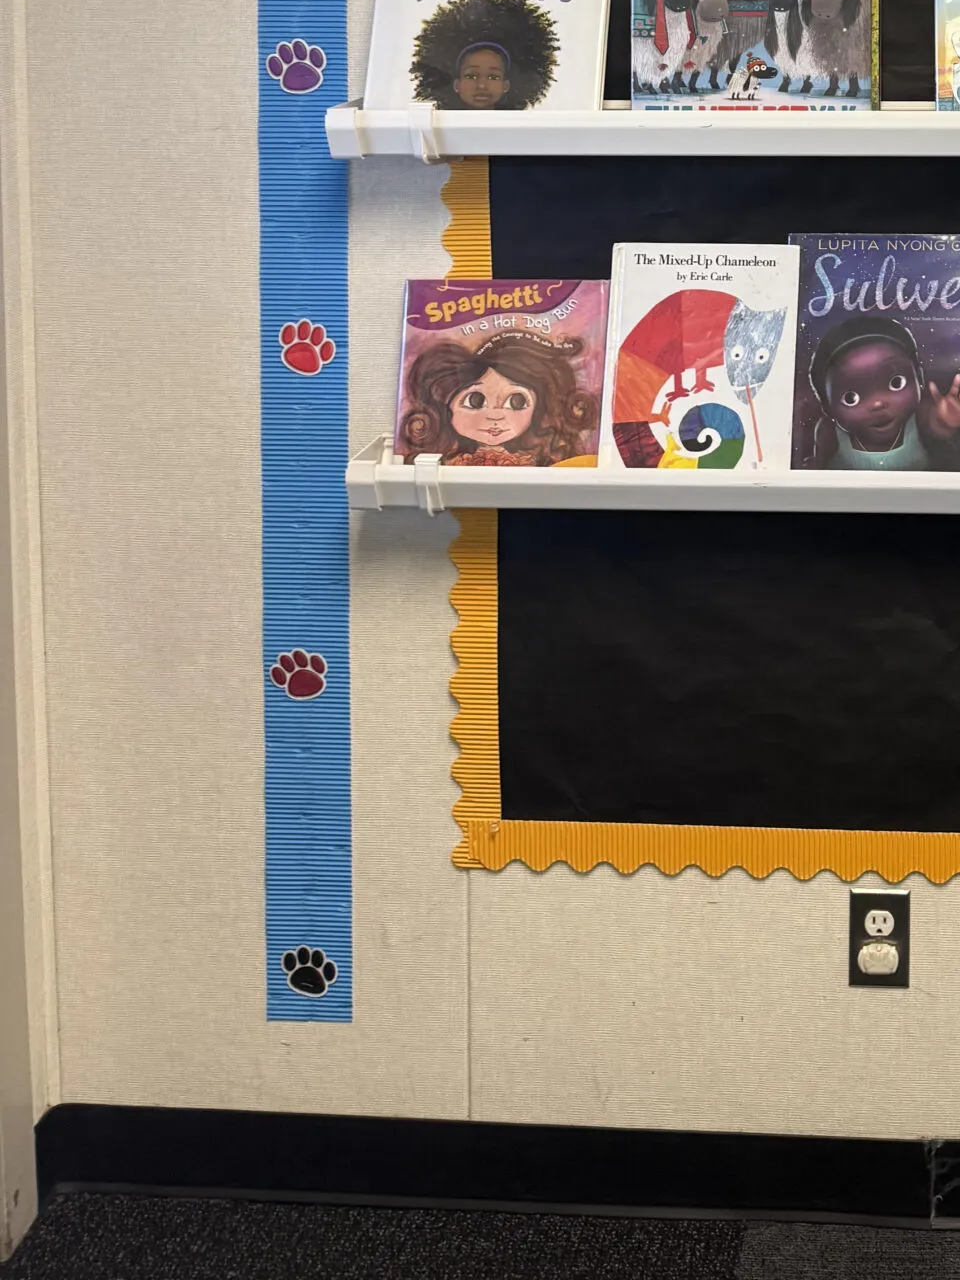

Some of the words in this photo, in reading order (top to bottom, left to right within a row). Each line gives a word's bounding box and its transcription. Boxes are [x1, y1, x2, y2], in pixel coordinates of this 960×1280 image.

[818, 239, 879, 251] LUPITA
[634, 253, 656, 265] The
[659, 254, 713, 269] Mixed-Up
[715, 254, 777, 267] Chameleon
[676, 272, 687, 283] by
[690, 272, 708, 281] Eric
[710, 272, 733, 281] Carle
[424, 283, 543, 323] Spaghetti
[480, 320, 489, 330] a
[494, 315, 516, 327] Hot
[523, 315, 551, 334] Dog
[552, 298, 578, 320] Bun
